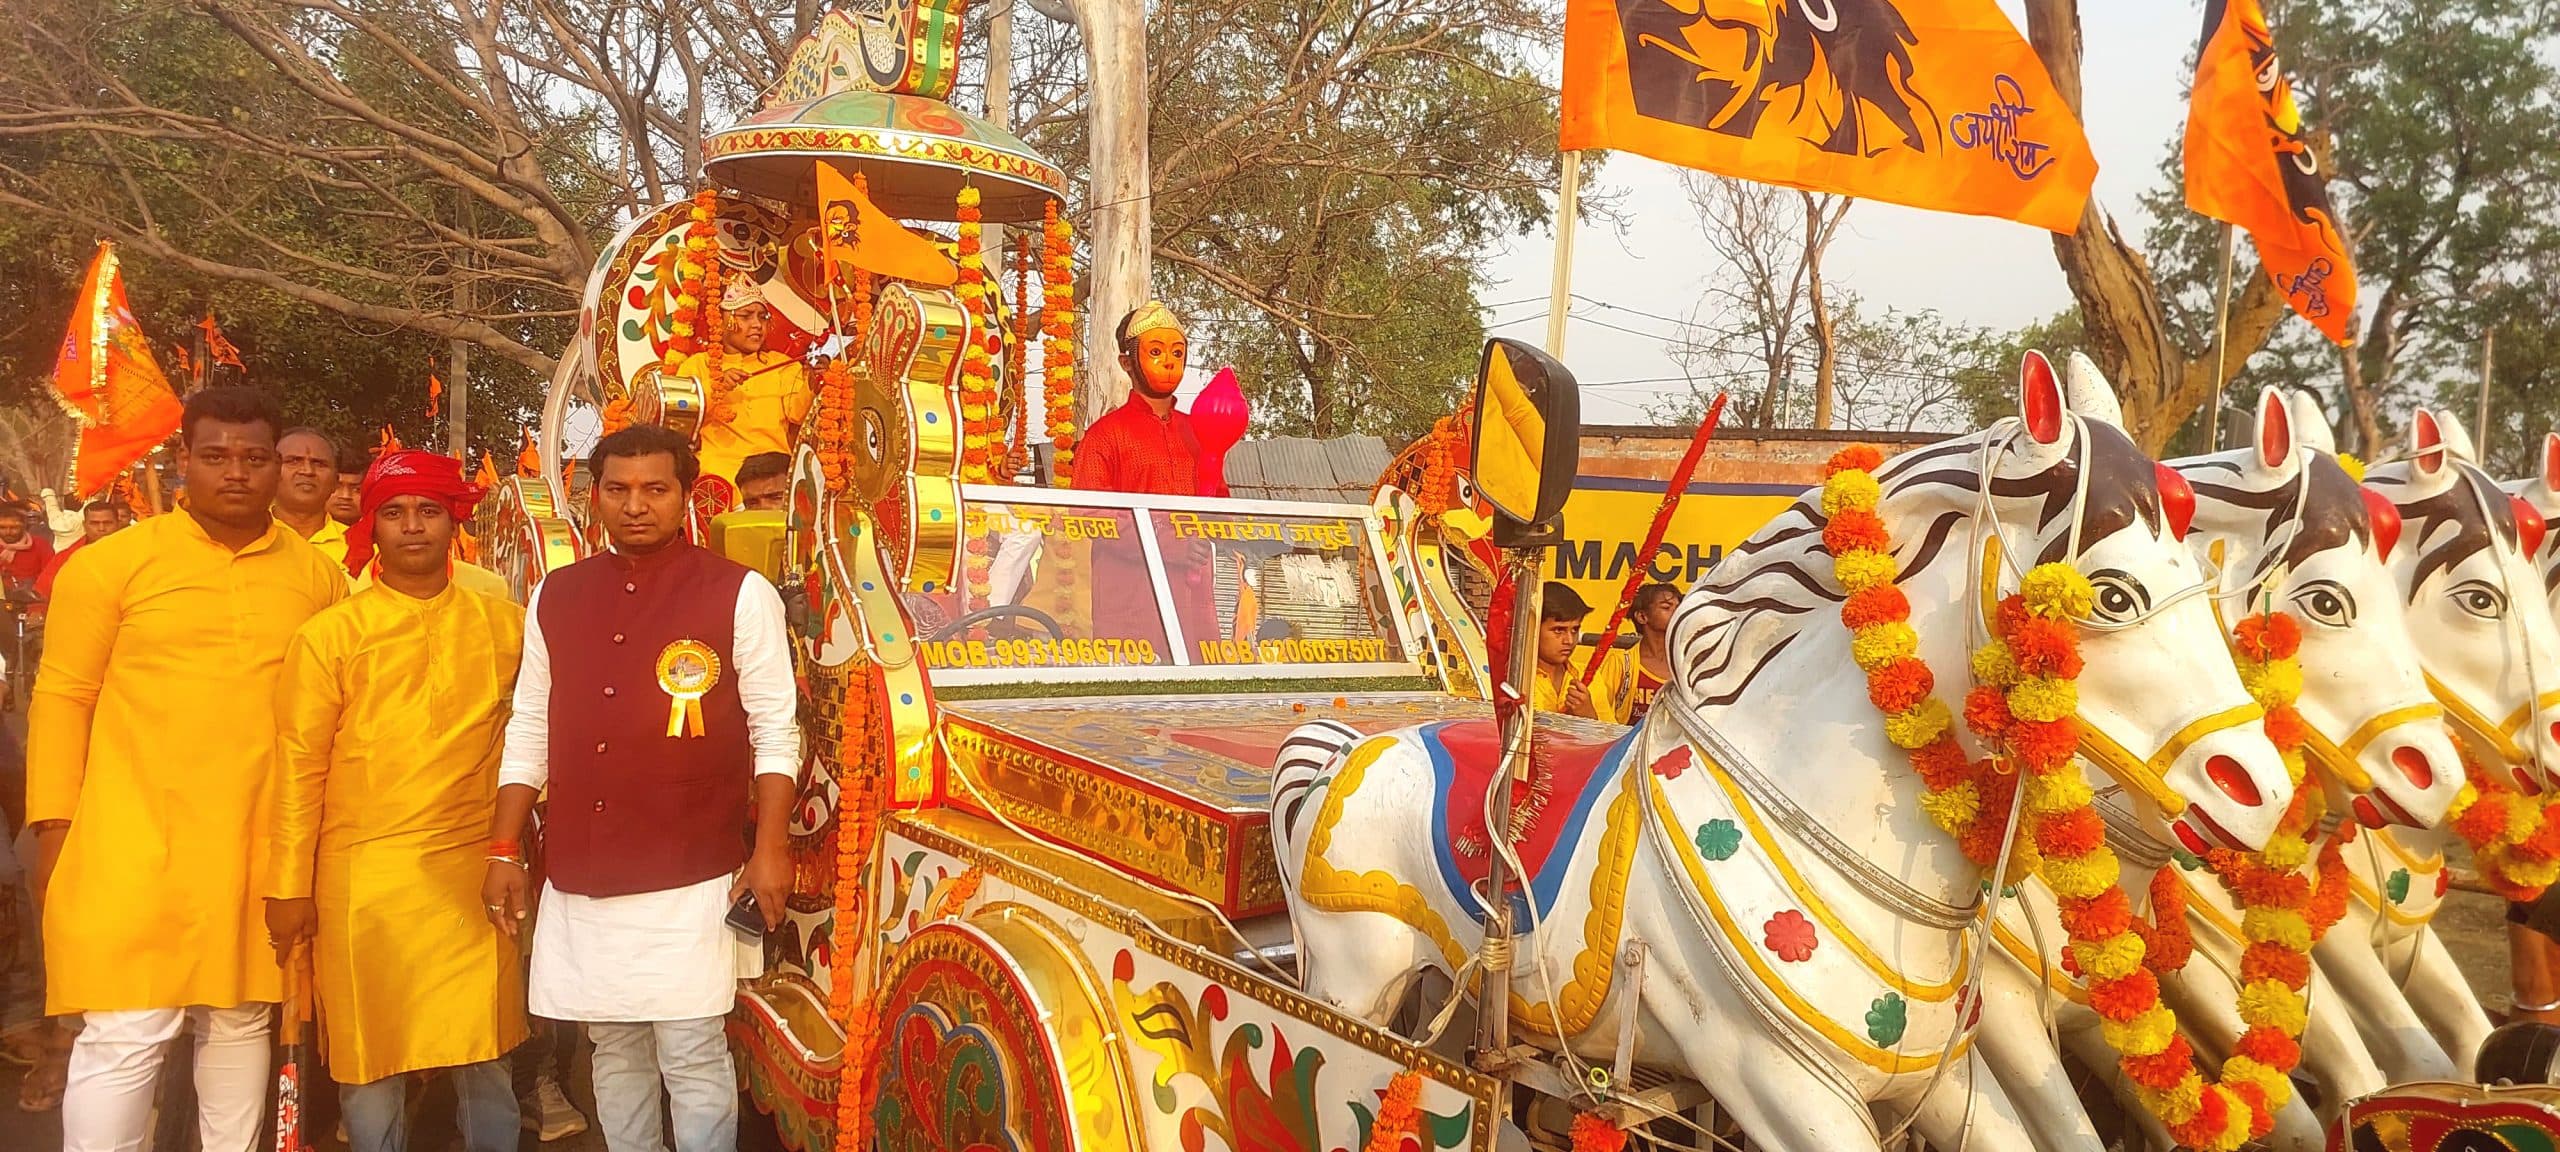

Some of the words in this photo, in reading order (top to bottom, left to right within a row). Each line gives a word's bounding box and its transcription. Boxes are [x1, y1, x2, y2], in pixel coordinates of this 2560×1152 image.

[1061, 515, 1121, 541] हाउस
[1169, 512, 1285, 542] निमारंग
[1286, 519, 1354, 551] जमुई
[919, 638, 1155, 668] MOB.9931066709
